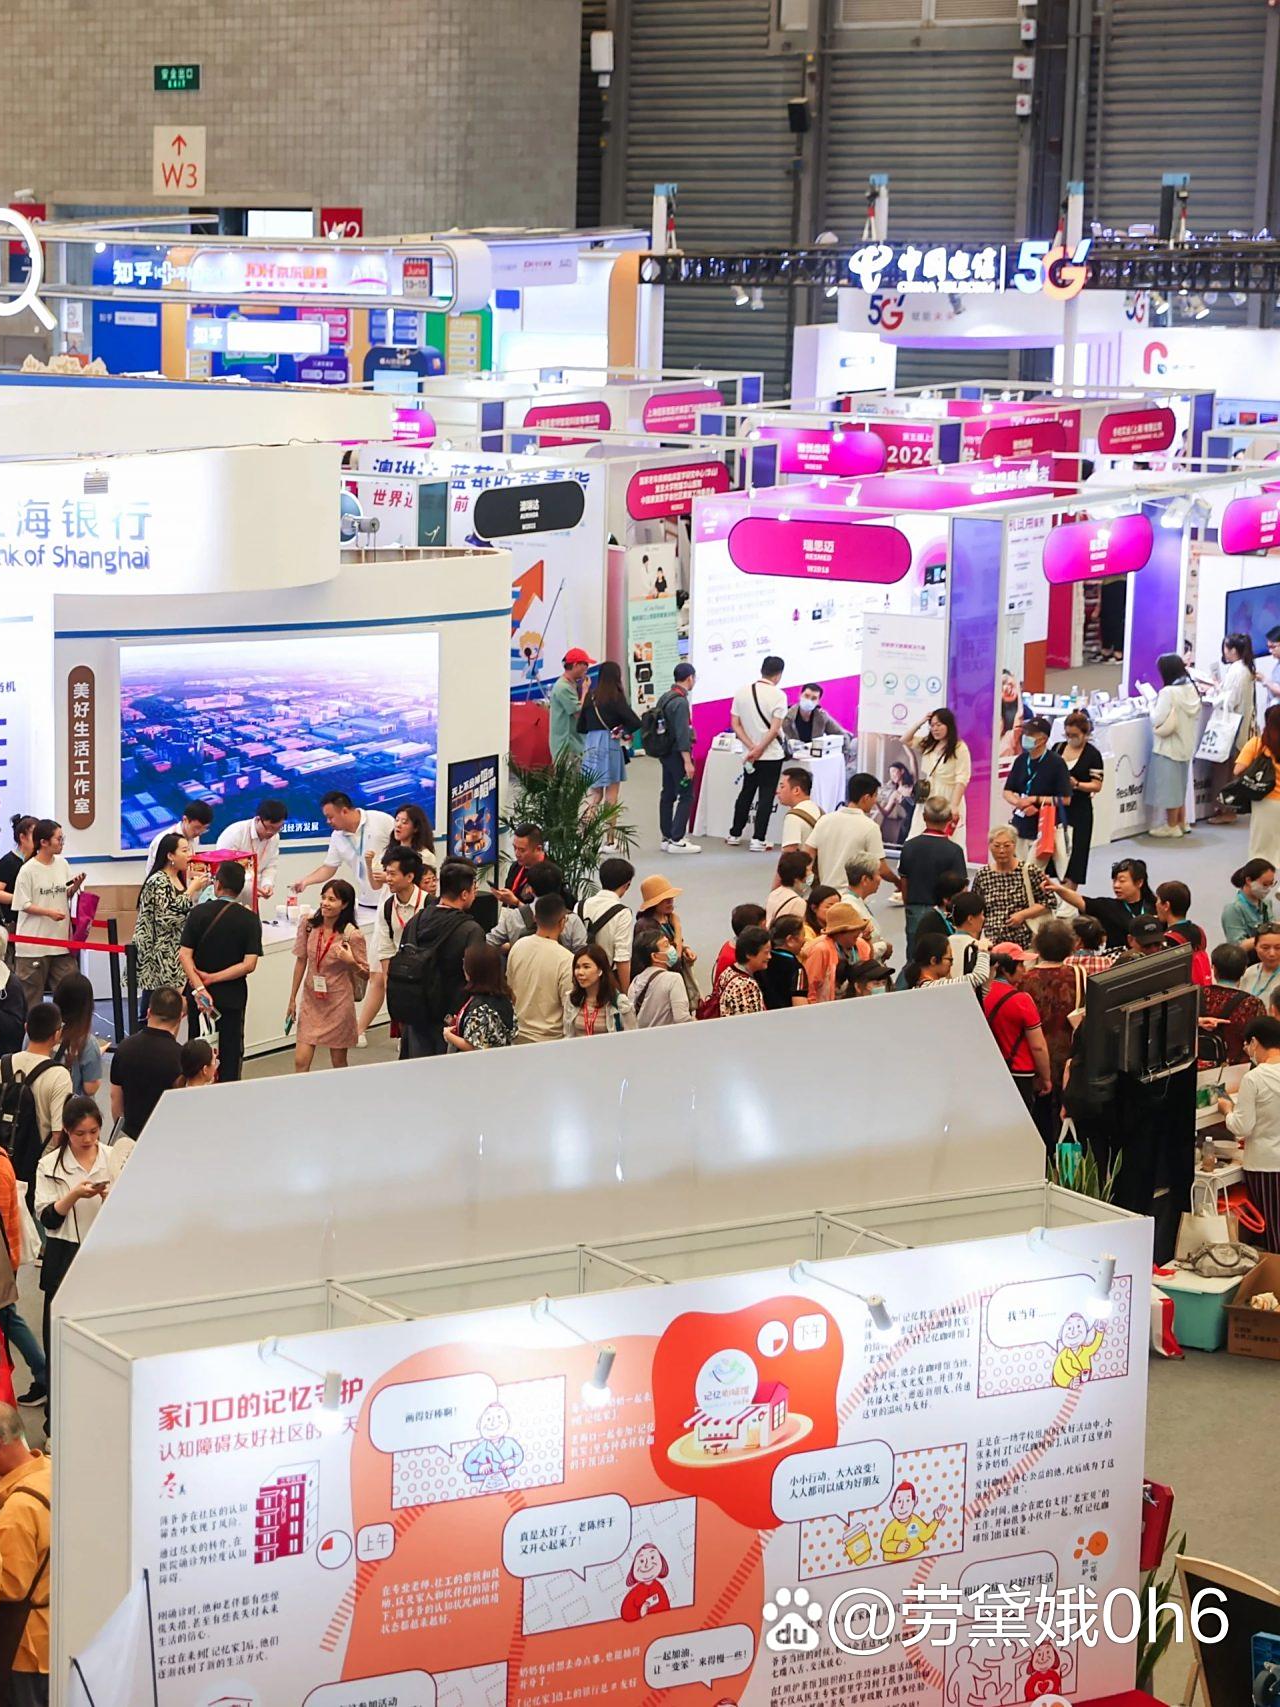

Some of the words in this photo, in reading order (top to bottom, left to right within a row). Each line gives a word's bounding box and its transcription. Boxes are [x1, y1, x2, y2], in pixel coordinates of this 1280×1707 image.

[161, 162, 198, 189] W3
[113, 260, 155, 286] 知乎
[897, 246, 998, 282] 中国电信
[868, 294, 906, 330] 5G
[453, 494, 470, 514] 前
[23, 544, 46, 567] of
[52, 545, 151, 575] Shanghai
[72, 682, 91, 815] 美好生活工作室
[159, 1415, 360, 1462] 认知障碍友好社区的天
[789, 1475, 881, 1500] 人人都可以成为好朋友
[363, 1531, 390, 1553] 上午
